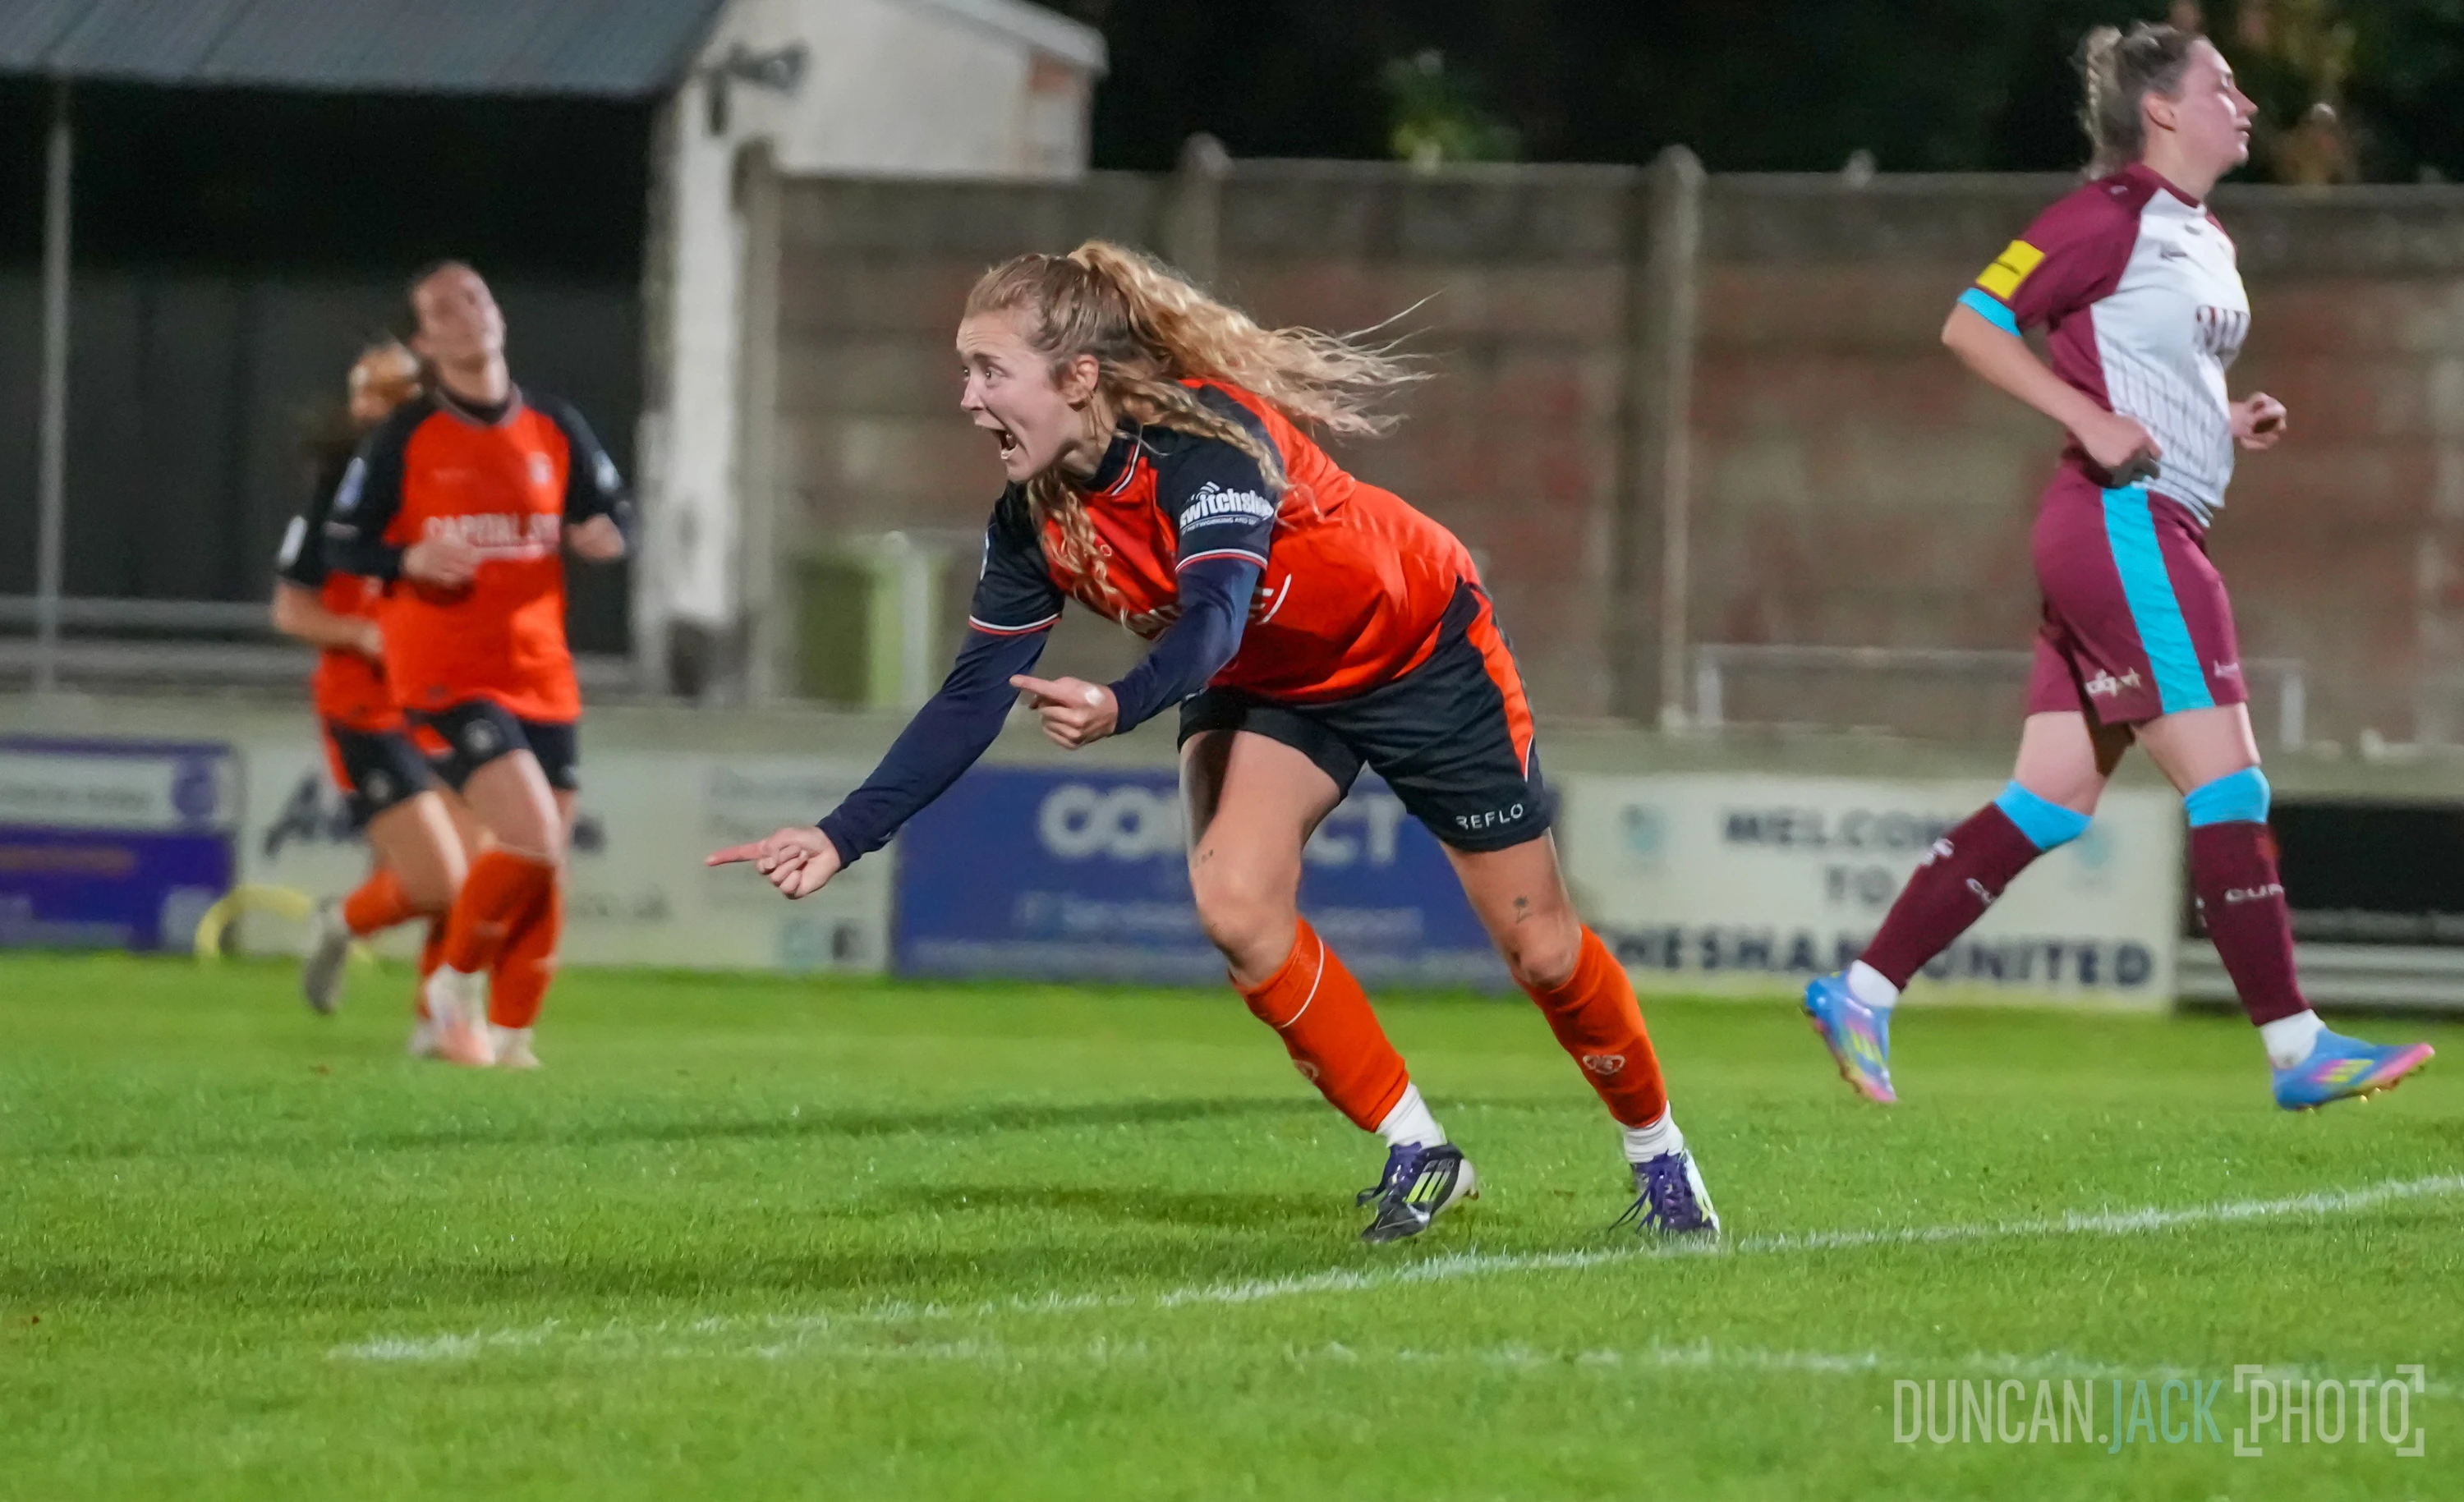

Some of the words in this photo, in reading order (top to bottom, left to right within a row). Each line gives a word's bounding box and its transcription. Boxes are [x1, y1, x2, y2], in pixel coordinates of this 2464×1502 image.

[1037, 783, 1401, 866] COCT
[1455, 803, 1524, 830] REFLO
[1823, 862, 1896, 905] TO
